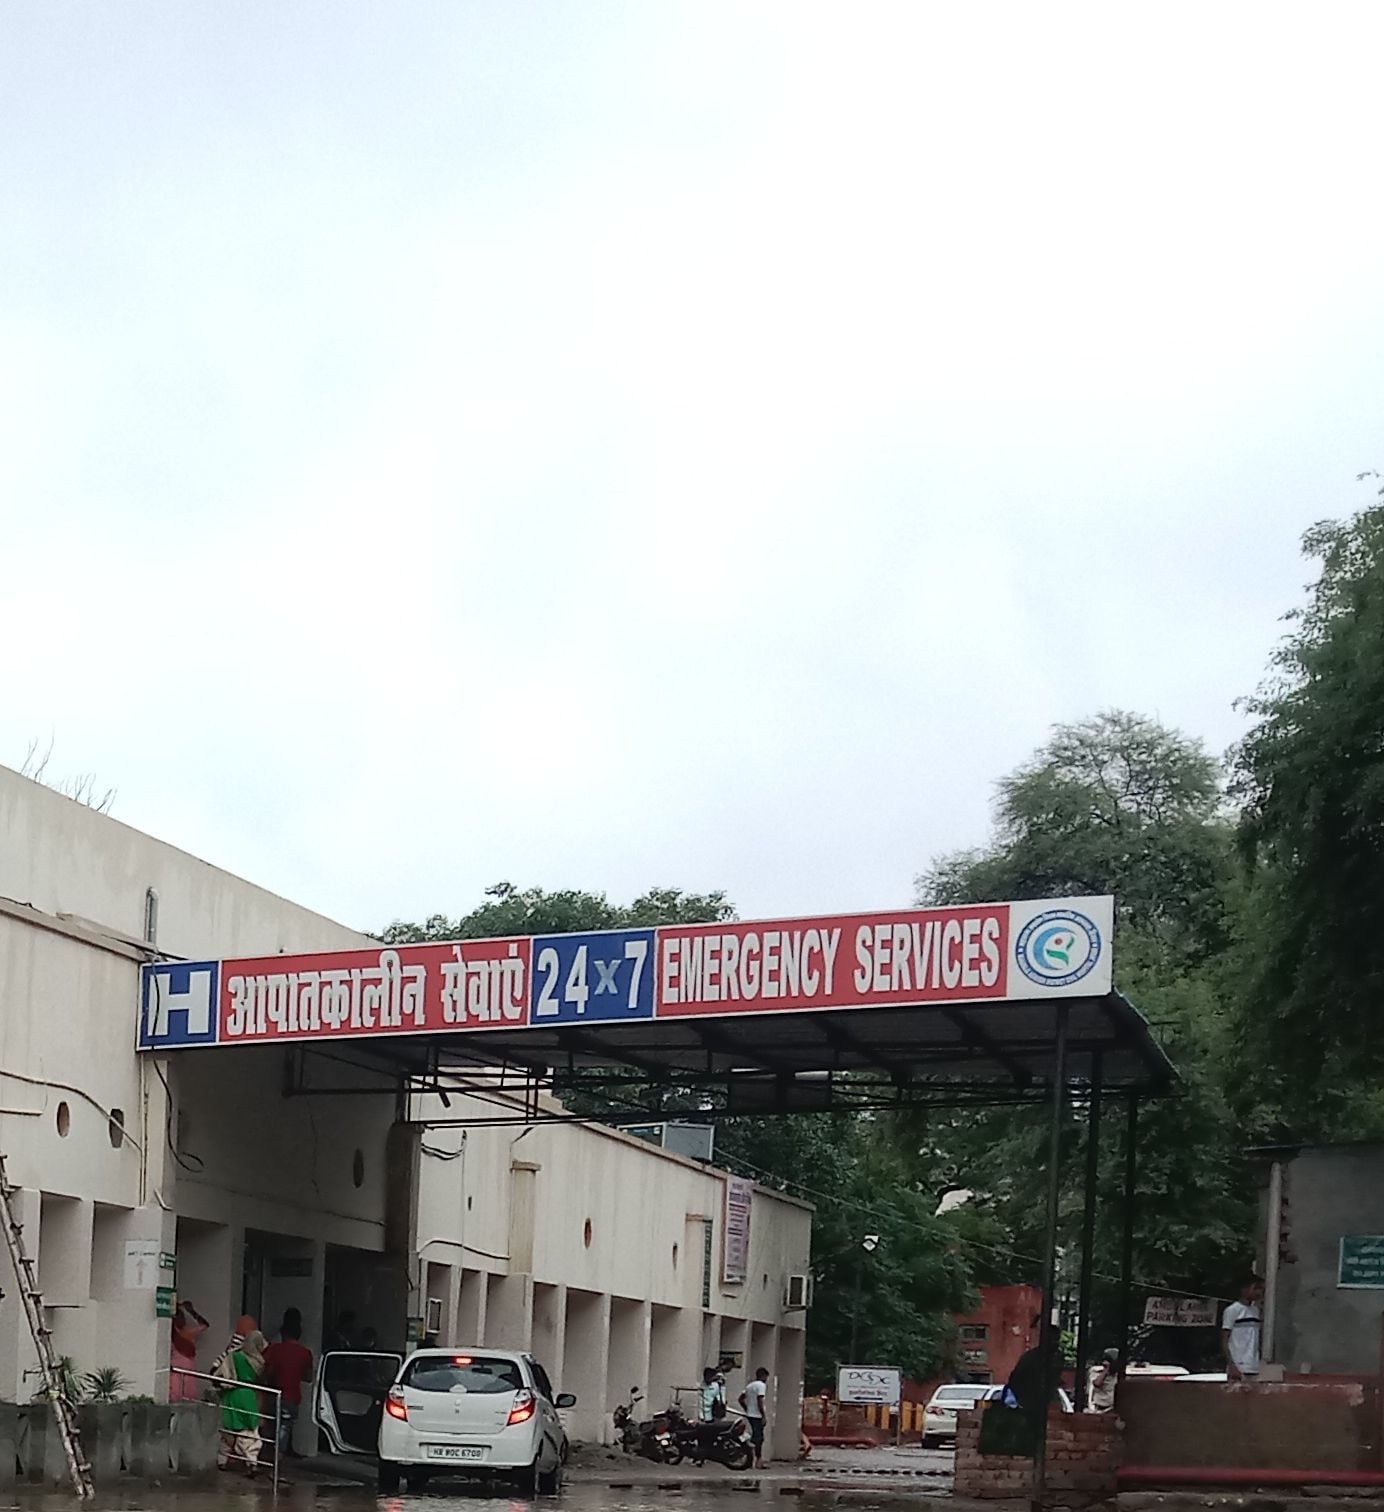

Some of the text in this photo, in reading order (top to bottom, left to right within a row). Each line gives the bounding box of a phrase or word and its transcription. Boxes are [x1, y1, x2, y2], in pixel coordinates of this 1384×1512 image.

[147, 970, 212, 1037] H
[226, 944, 526, 1036] आपातकालीन सेवाएं
[662, 927, 842, 1004] EMERGENCY
[854, 917, 1000, 995] SERVICES
